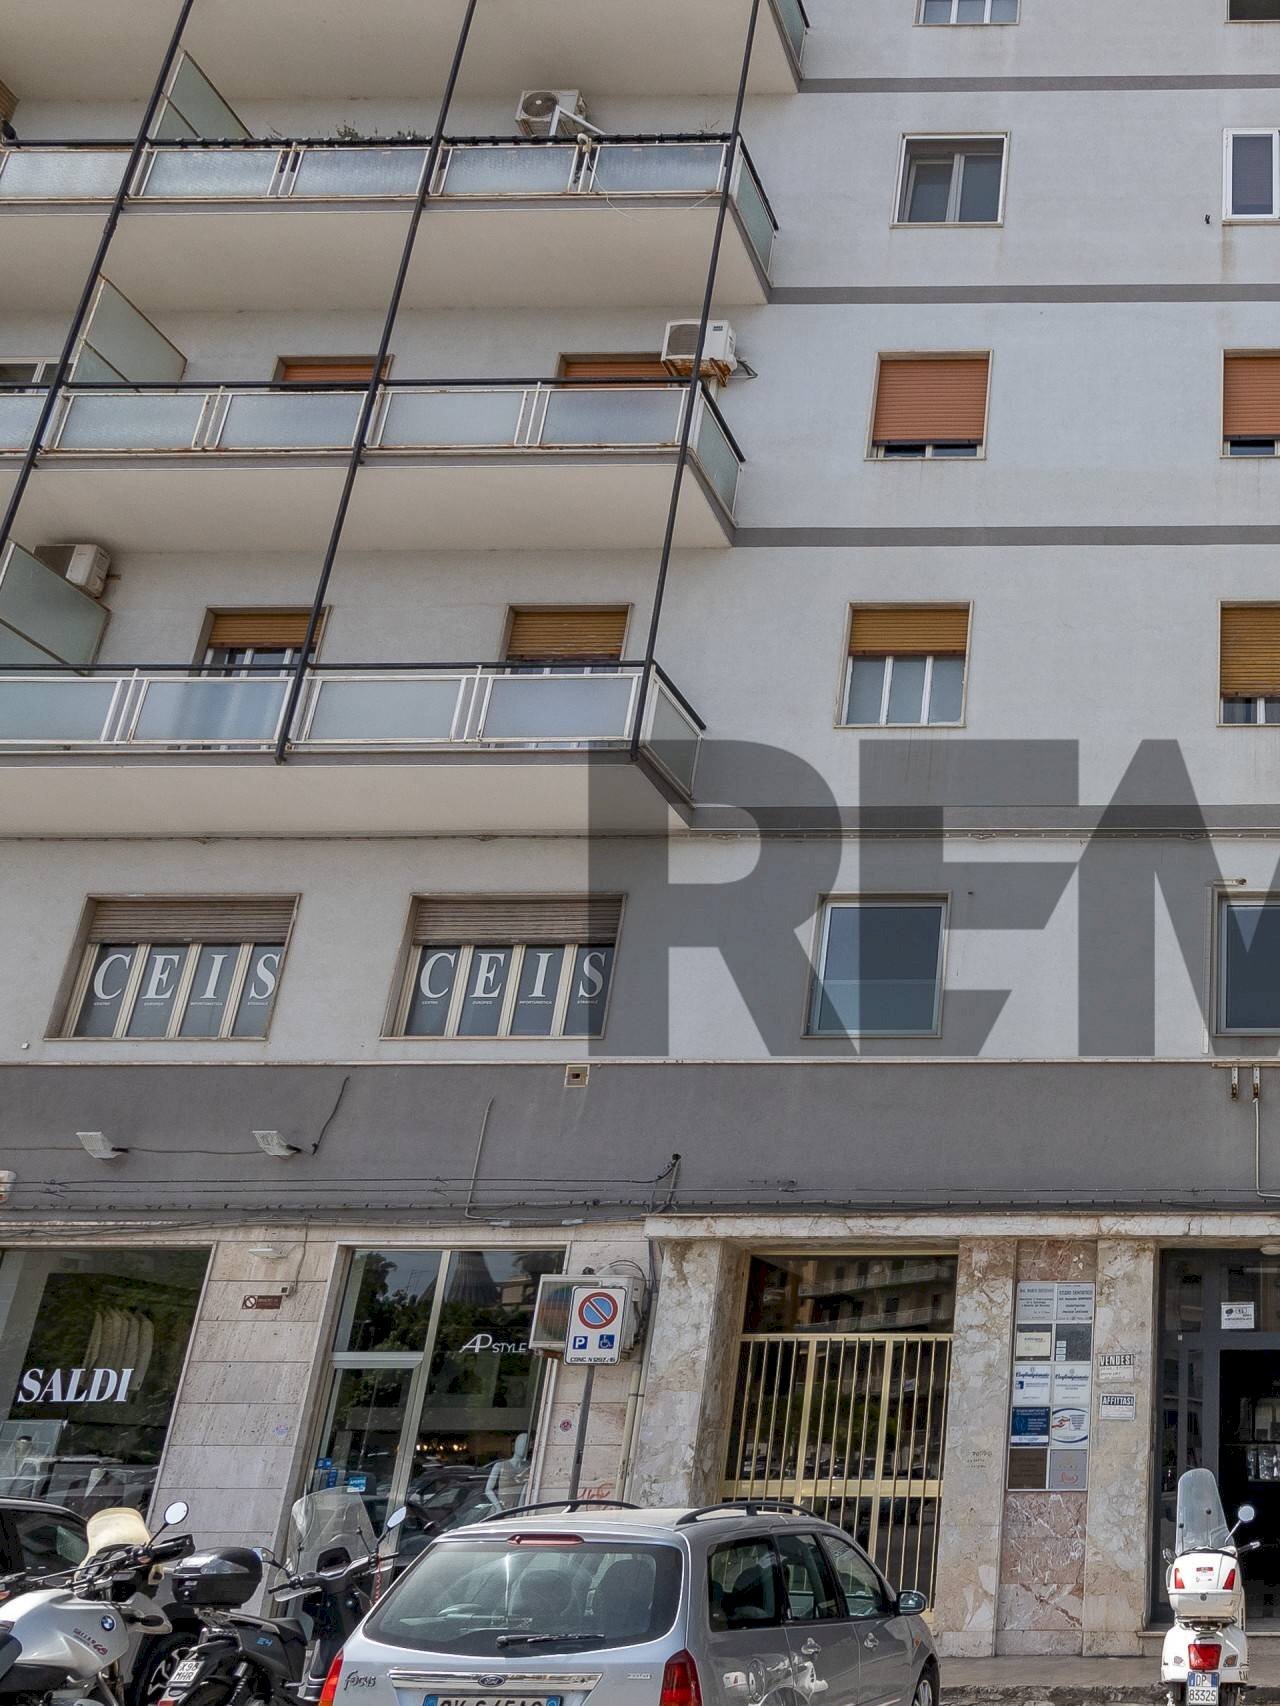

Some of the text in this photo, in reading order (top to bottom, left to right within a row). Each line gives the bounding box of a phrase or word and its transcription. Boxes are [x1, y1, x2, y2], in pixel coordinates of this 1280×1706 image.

[93, 953, 281, 1000] CEIS
[419, 952, 607, 998] CEIS
[492, 1342, 527, 1353] STYLE
[1100, 1354, 1133, 1366] VENDESI
[17, 1368, 135, 1403] SALDI
[1102, 1396, 1134, 1405] AFFITTASI
